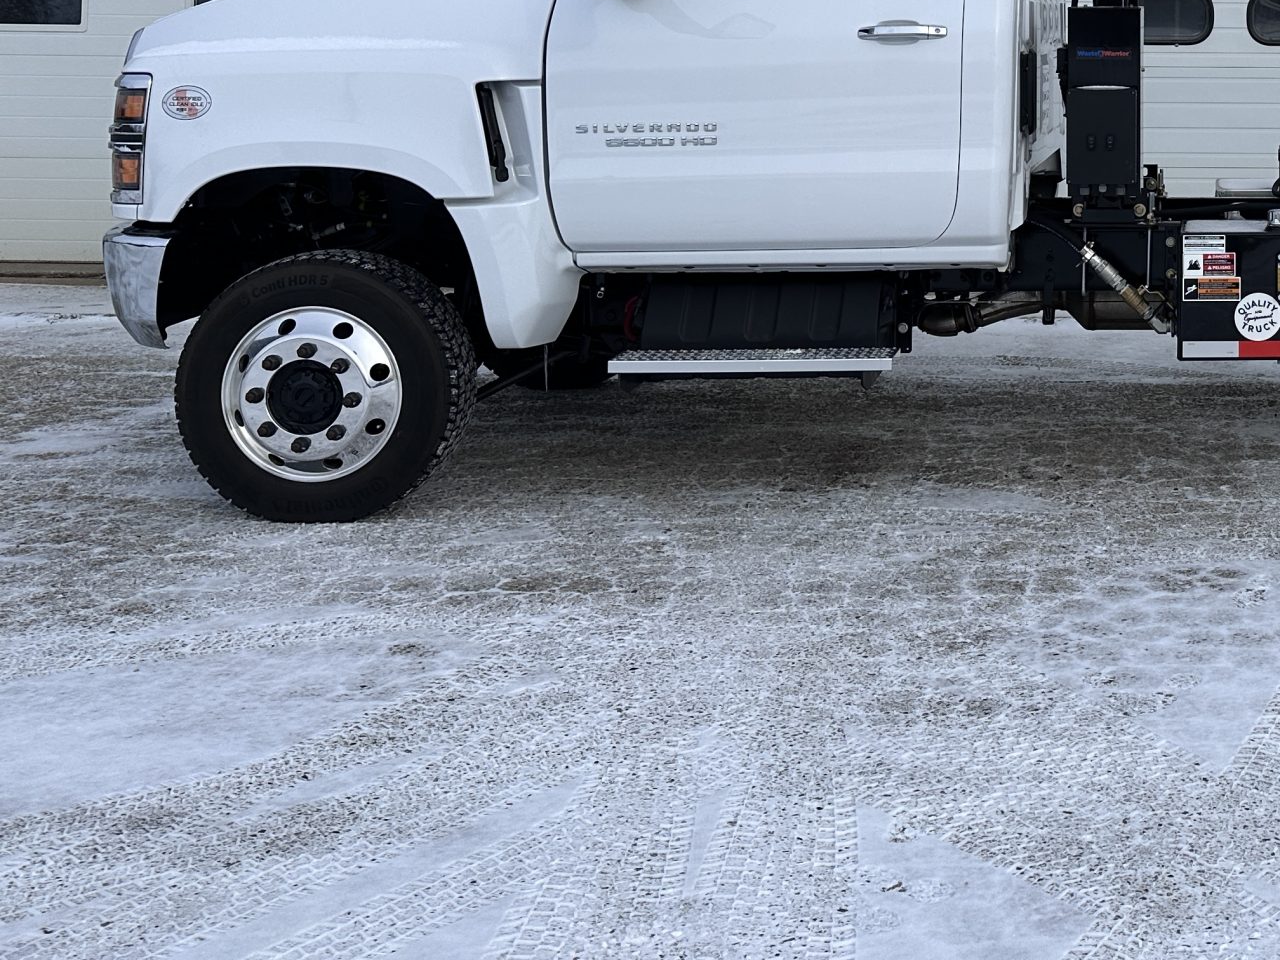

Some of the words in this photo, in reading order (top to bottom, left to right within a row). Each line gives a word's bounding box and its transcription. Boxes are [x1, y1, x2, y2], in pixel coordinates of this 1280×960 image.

[575, 123, 717, 134] SILVERADO
[681, 136, 717, 146] HD
[251, 276, 286, 298] Conti
[287, 274, 317, 287] HDR
[319, 274, 329, 286] 5
[1238, 300, 1278, 315] QUALITY
[1242, 319, 1277, 332] TRUCK
